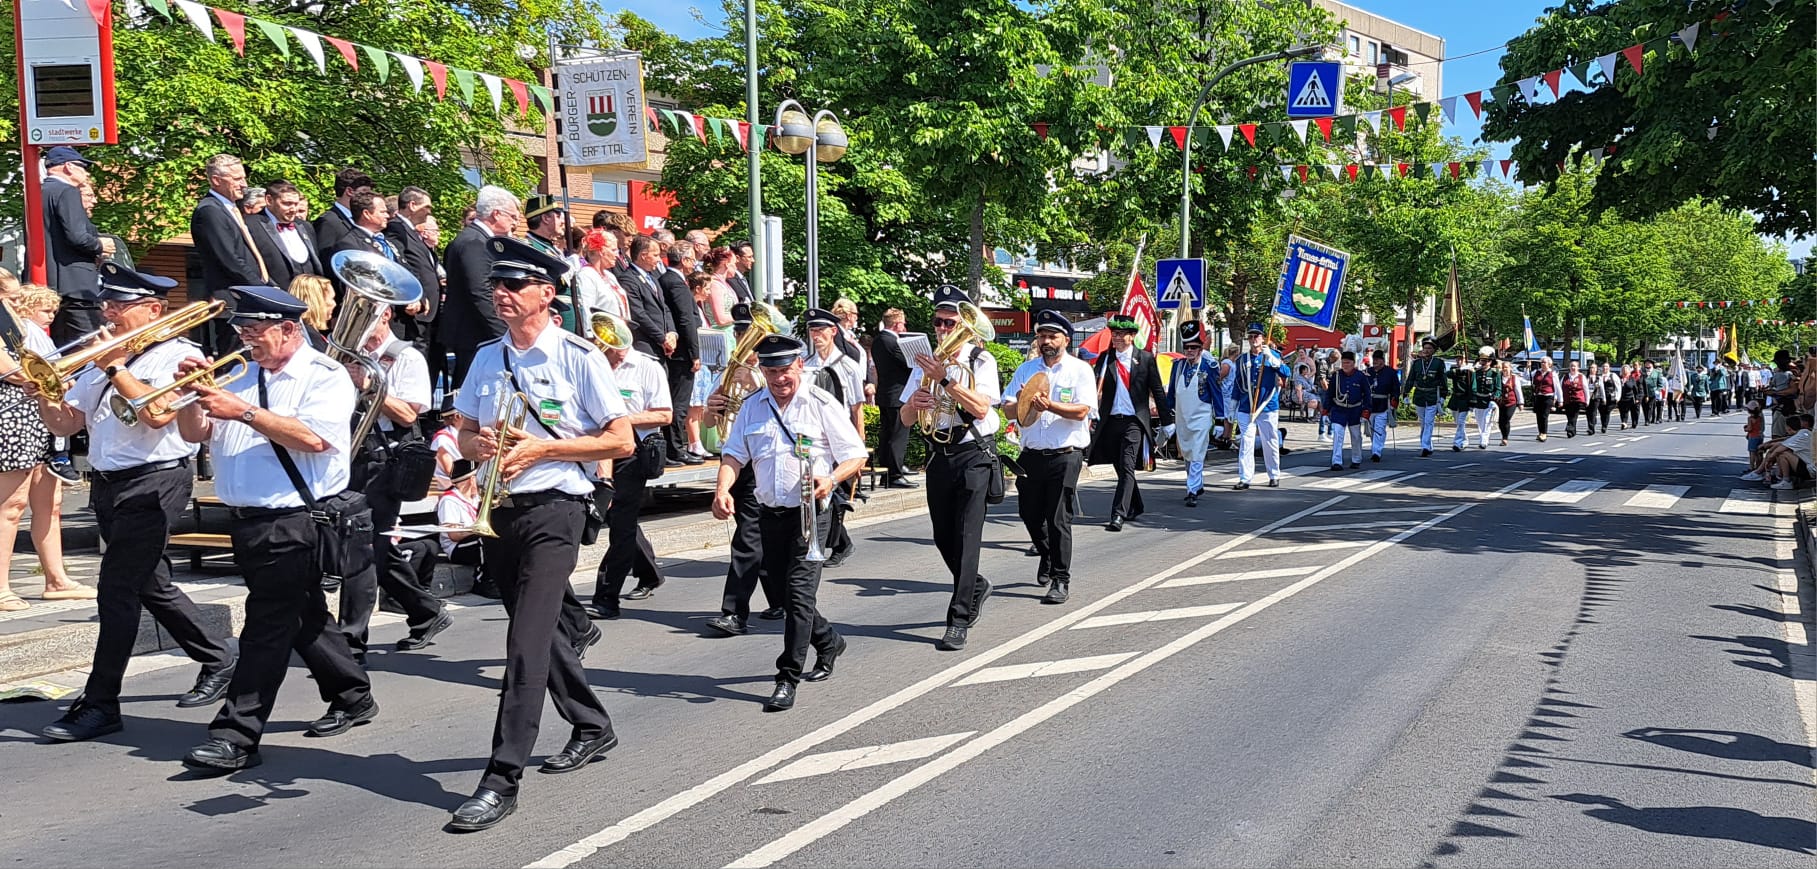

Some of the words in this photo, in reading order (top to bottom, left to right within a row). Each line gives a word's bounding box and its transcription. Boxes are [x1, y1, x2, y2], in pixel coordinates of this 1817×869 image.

[573, 69, 631, 84] SCHÜTZEN-
[567, 86, 580, 141] BÜRGER-
[625, 88, 638, 135] VEREIN
[48, 128, 82, 136] stadtwerke
[1032, 286, 1047, 298] The
[1048, 287, 1073, 300] House
